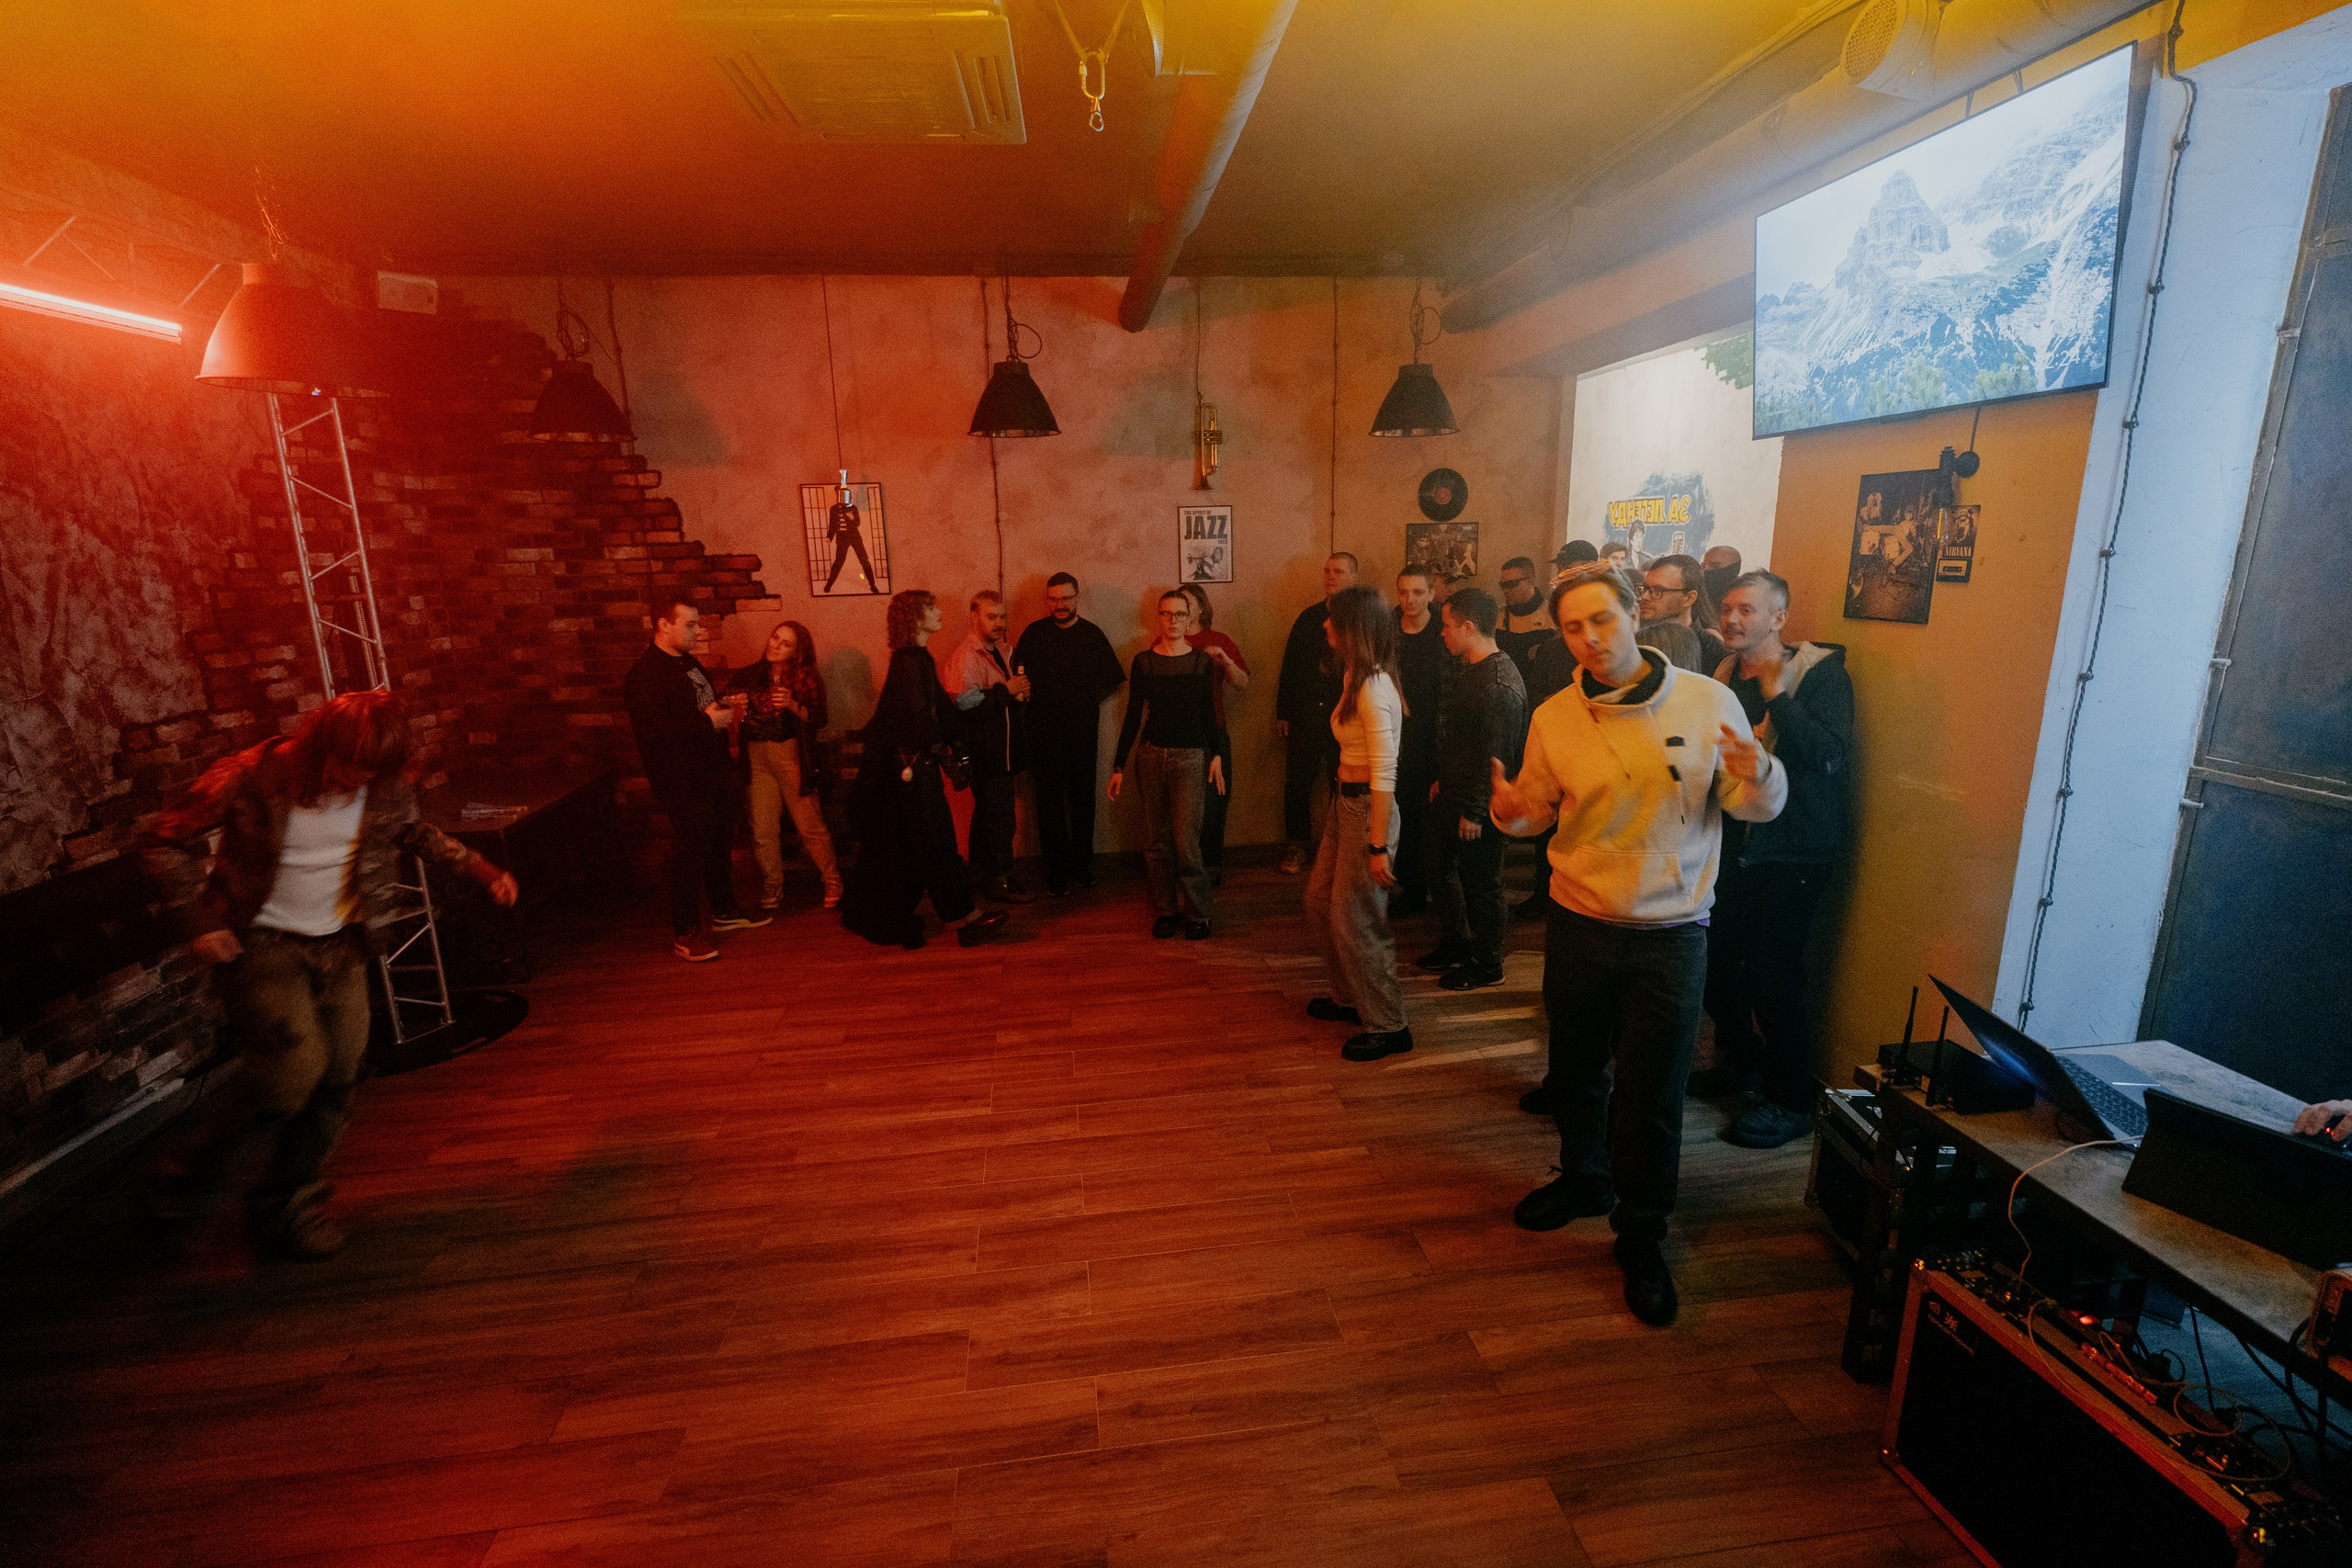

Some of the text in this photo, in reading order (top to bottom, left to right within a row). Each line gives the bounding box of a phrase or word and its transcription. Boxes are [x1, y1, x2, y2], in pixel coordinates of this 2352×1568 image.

[2034, 351, 2080, 370] 22:24
[1184, 515, 1227, 539] JAZZ
[1945, 547, 1972, 557] NIRVANA
